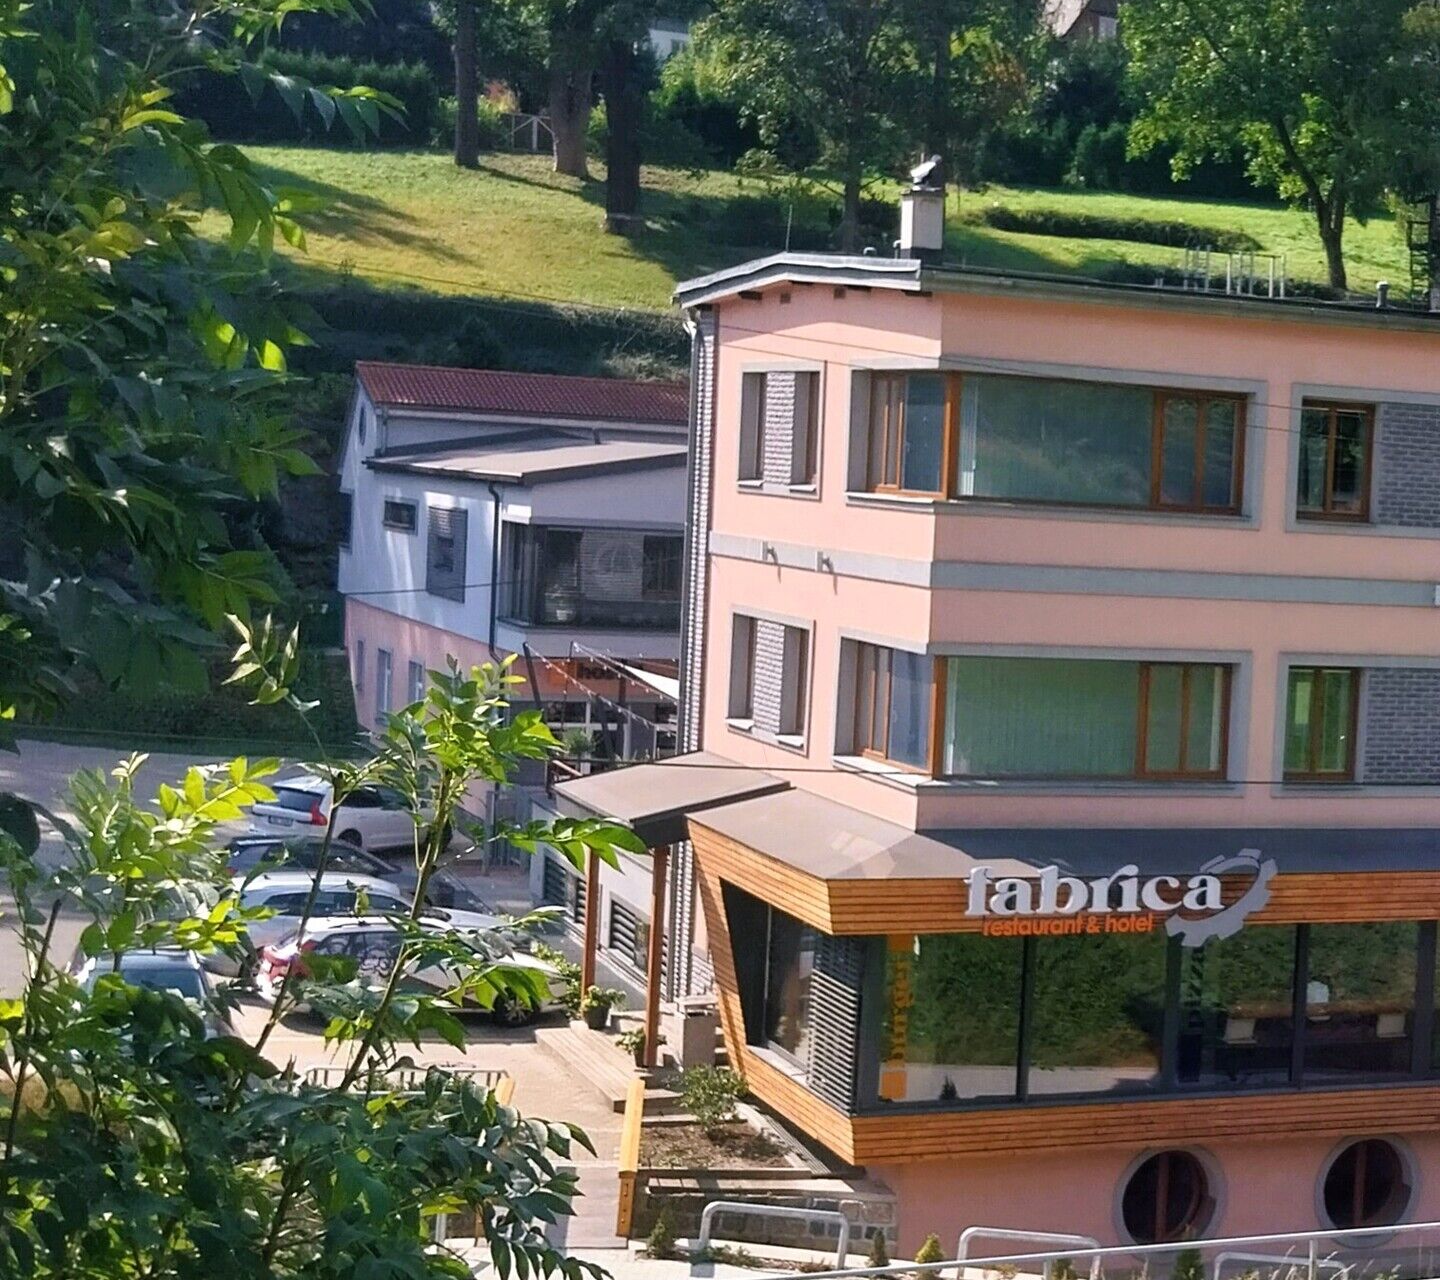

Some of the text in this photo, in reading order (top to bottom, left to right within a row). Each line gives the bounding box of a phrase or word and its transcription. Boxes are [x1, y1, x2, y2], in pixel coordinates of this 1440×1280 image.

[964, 864, 1226, 917] fabrica
[983, 913, 1154, 936] restaurant & hotel
